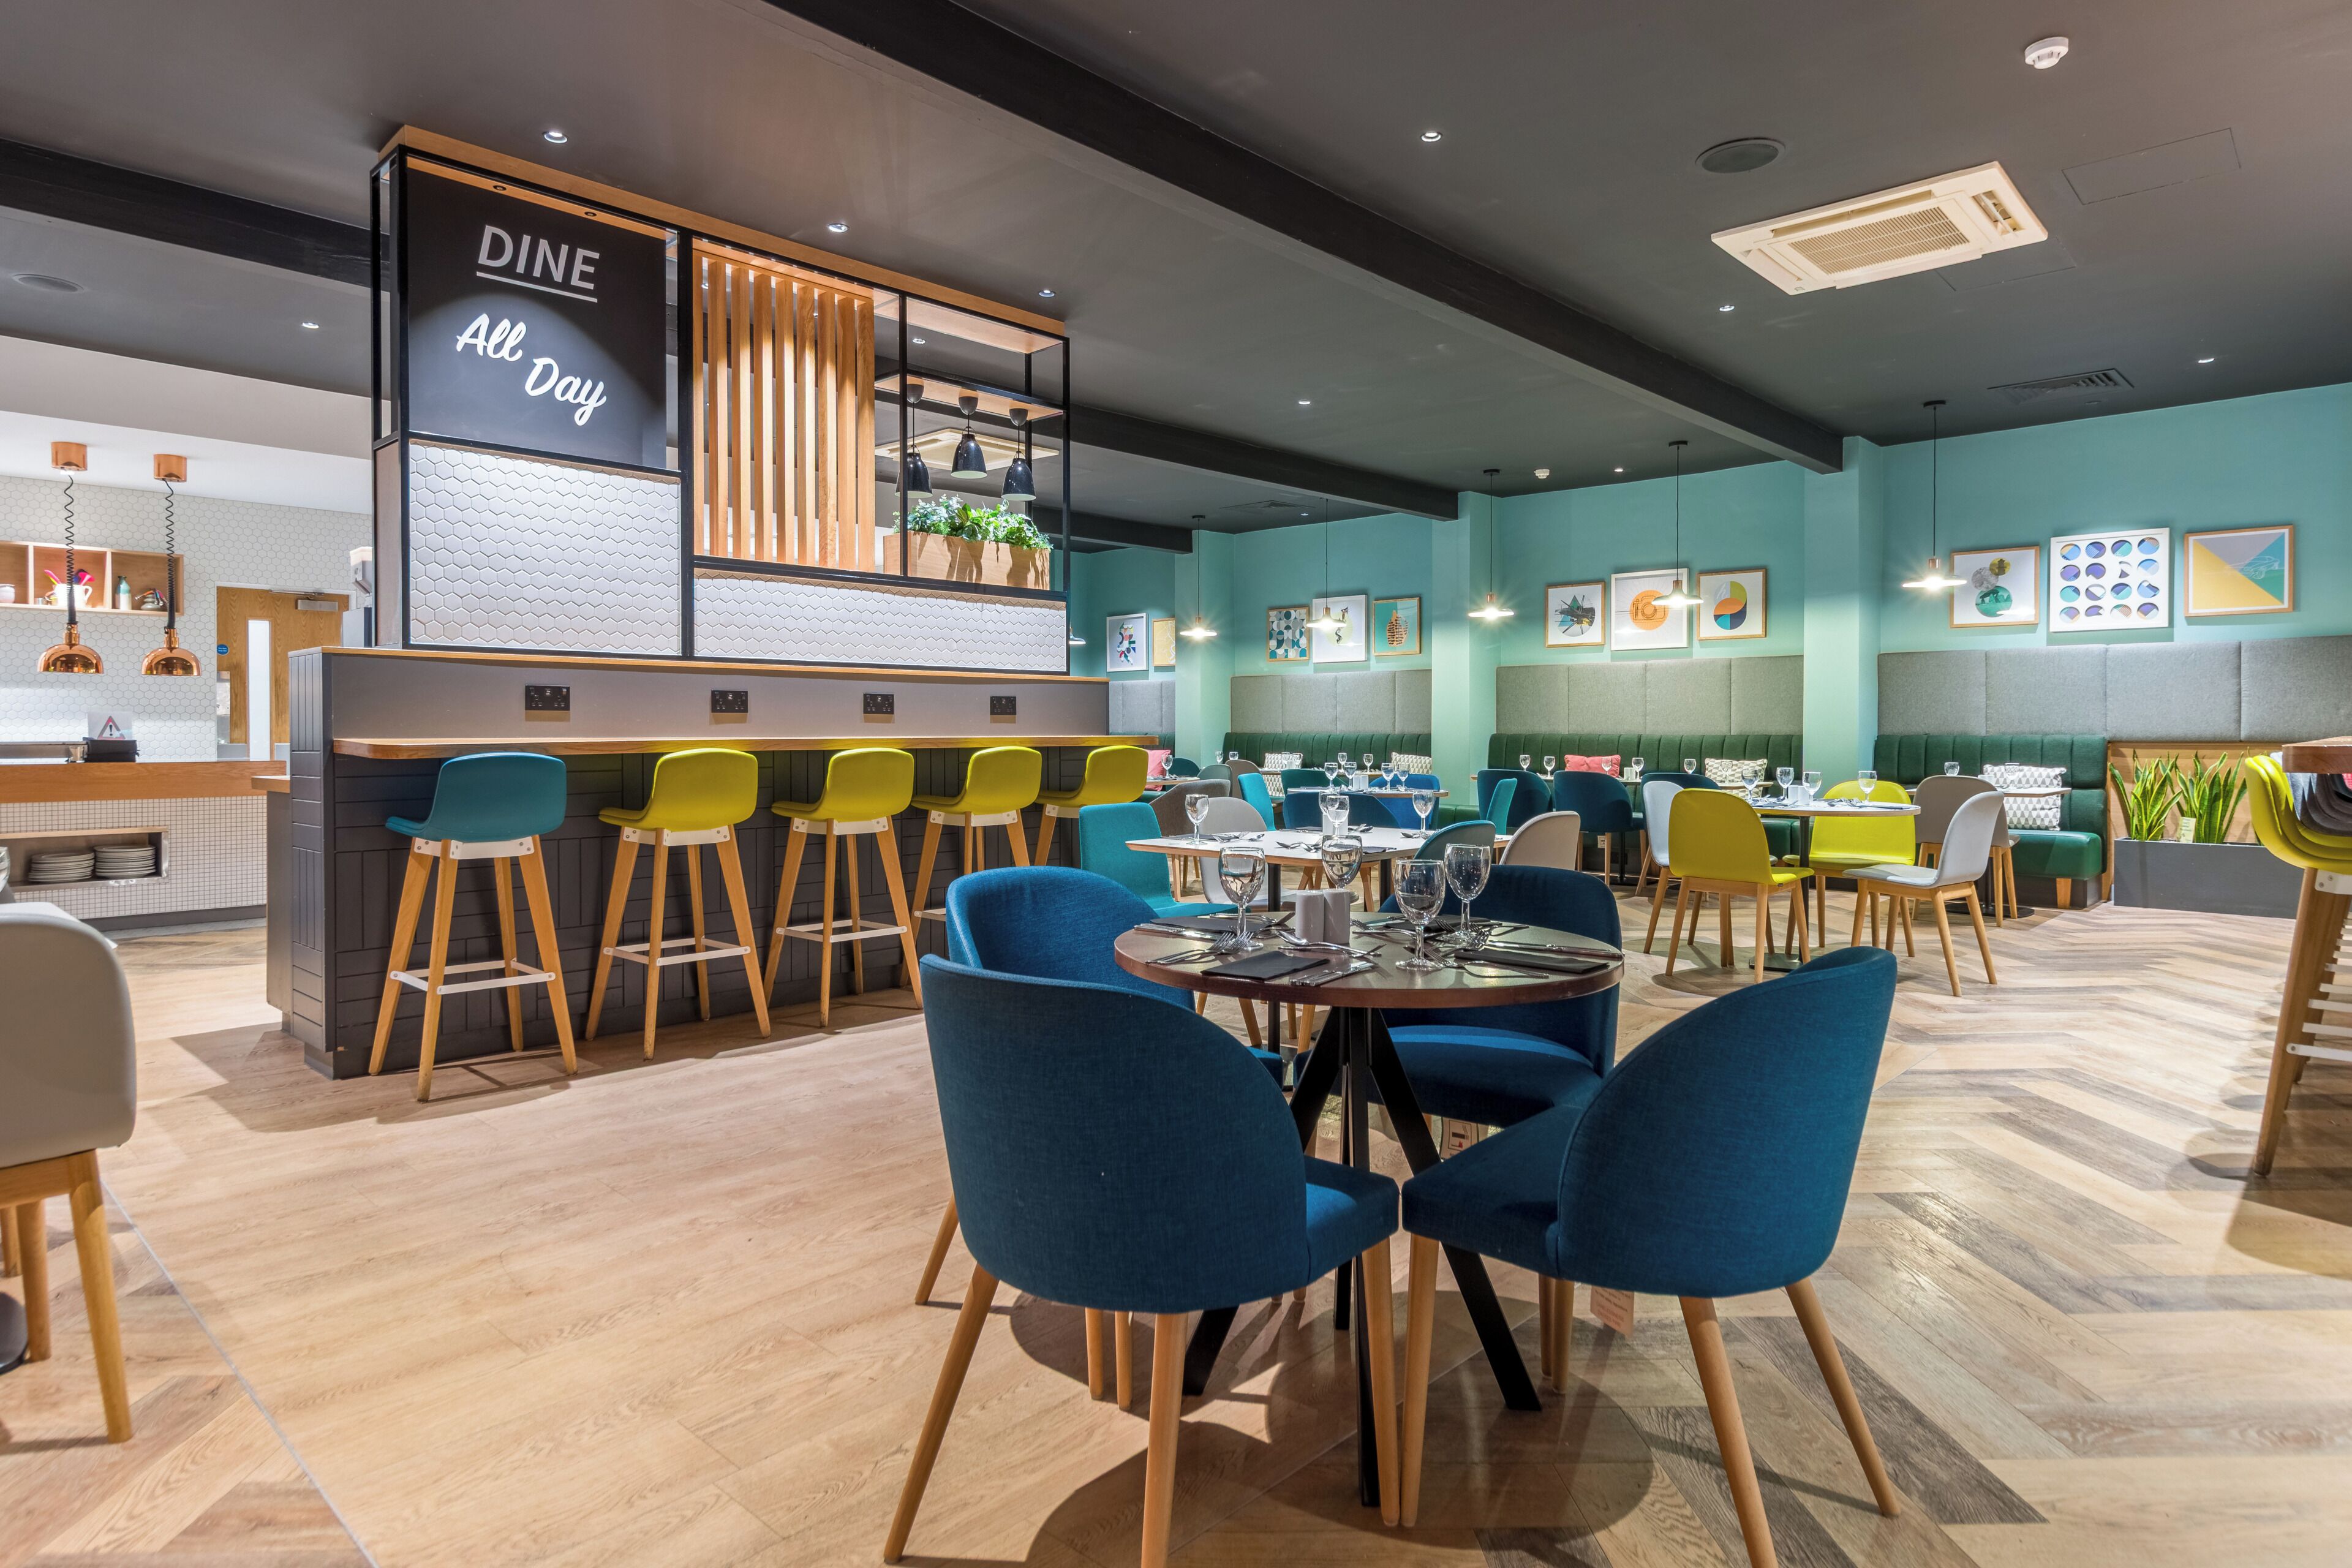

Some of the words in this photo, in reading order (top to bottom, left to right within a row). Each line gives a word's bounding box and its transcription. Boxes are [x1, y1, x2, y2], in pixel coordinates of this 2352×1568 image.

[478, 225, 600, 290] DINE
[456, 314, 526, 361] All
[525, 358, 606, 426] Day
